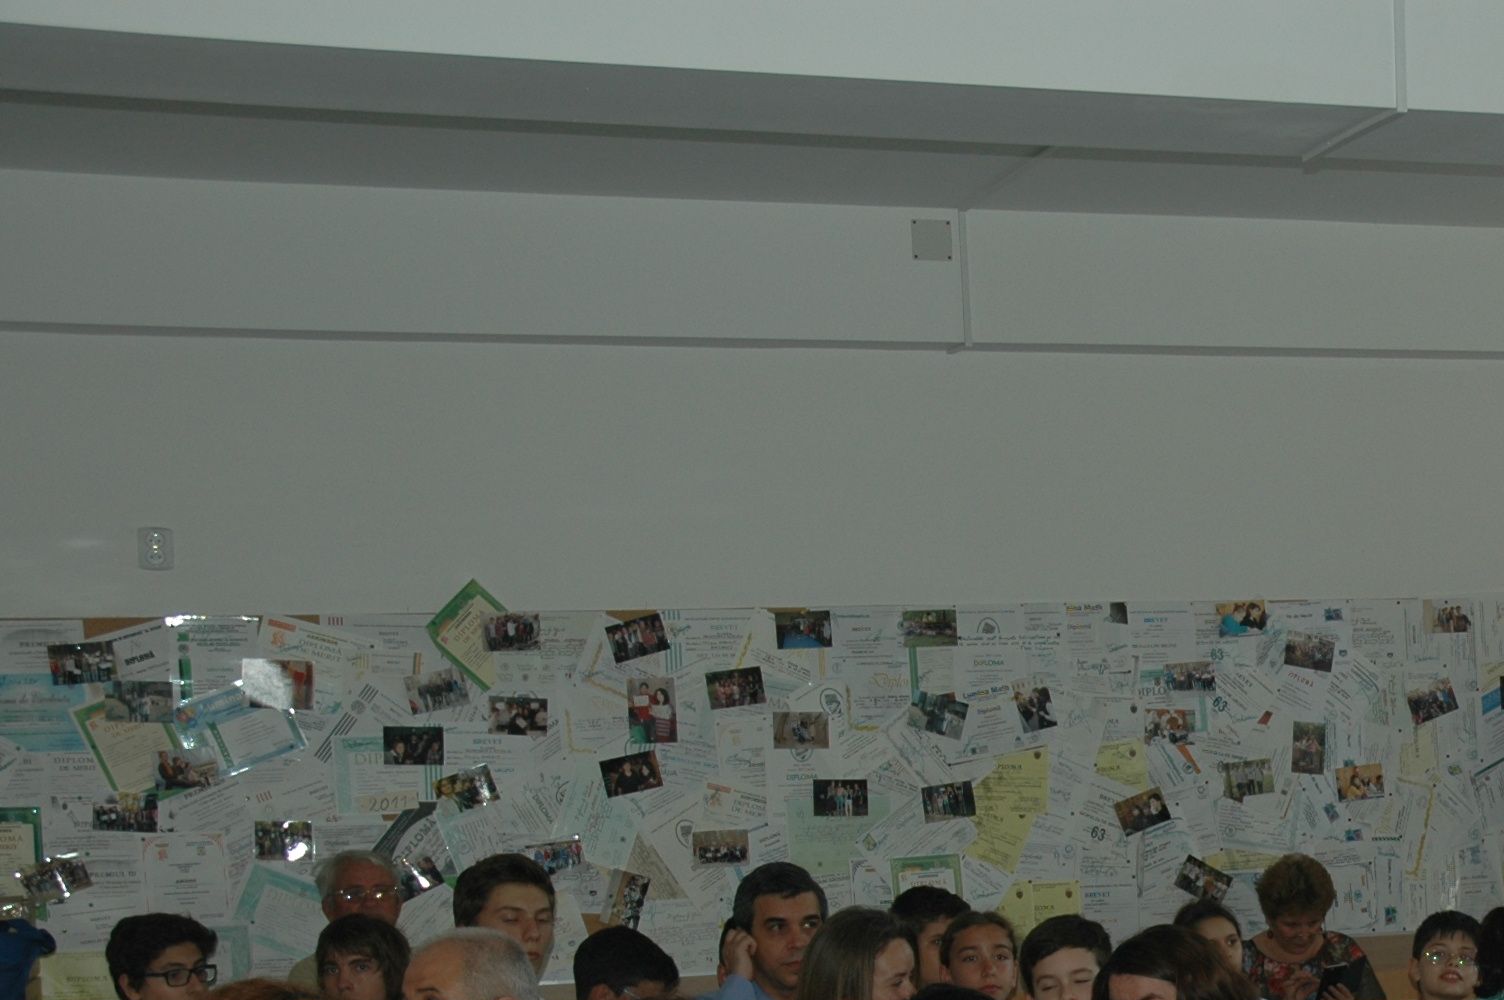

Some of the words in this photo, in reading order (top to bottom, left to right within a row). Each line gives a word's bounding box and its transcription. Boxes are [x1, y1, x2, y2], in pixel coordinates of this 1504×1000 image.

[54, 757, 95, 765] DIPLOM
[368, 795, 408, 812] 2011
[1090, 826, 1106, 841] 63
